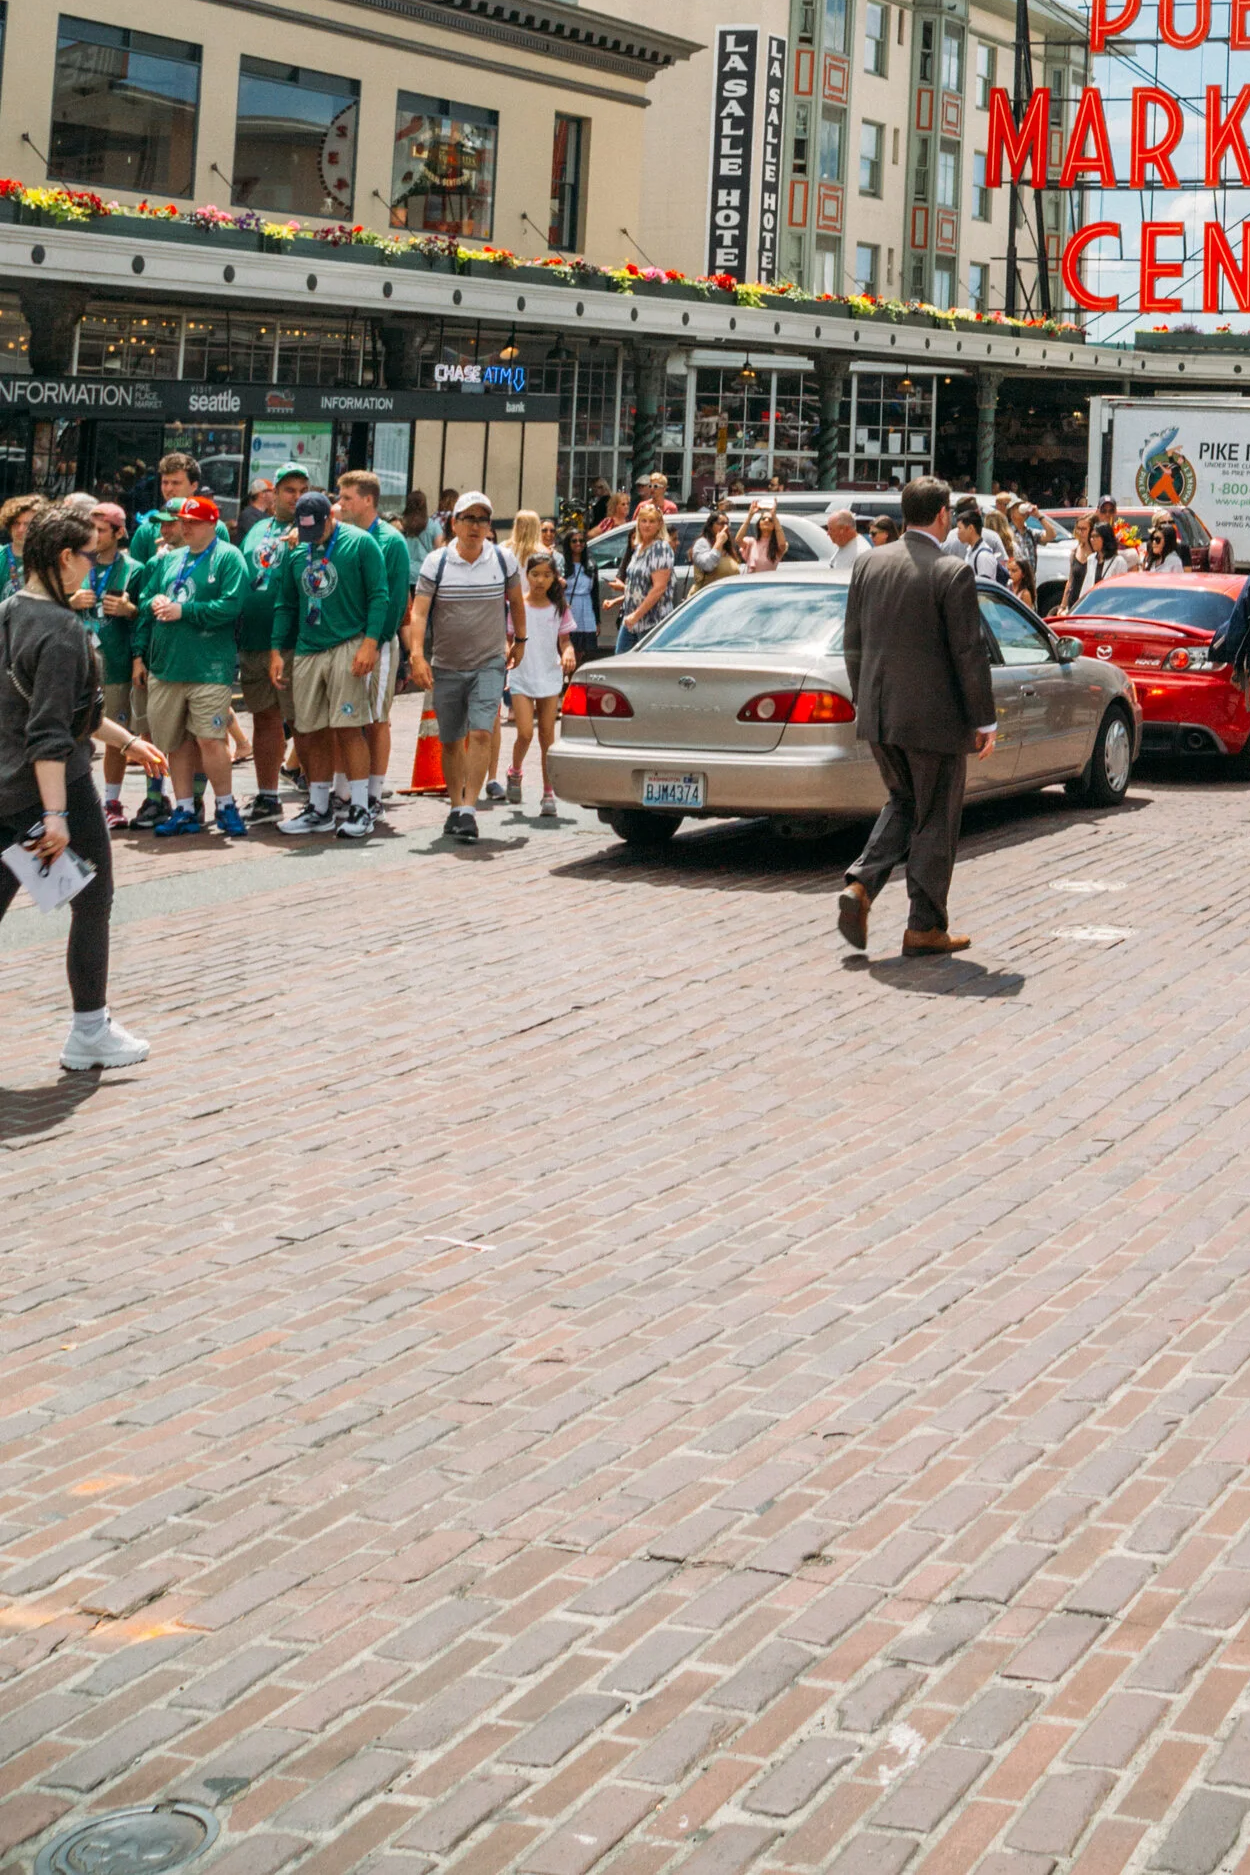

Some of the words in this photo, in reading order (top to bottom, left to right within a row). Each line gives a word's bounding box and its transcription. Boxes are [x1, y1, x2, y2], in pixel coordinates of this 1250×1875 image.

[722, 34, 749, 72] LA
[769, 40, 782, 78] LA
[719, 78, 748, 176] SALLE
[765, 88, 780, 182] SALLE
[434, 363, 482, 383] CHASE
[482, 365, 517, 385] ATM
[188, 389, 241, 412] seattle
[321, 396, 394, 410] INFORMATION
[505, 401, 525, 413] bank
[1199, 442, 1240, 461] PIKE
[646, 783, 699, 802] BJM4374
